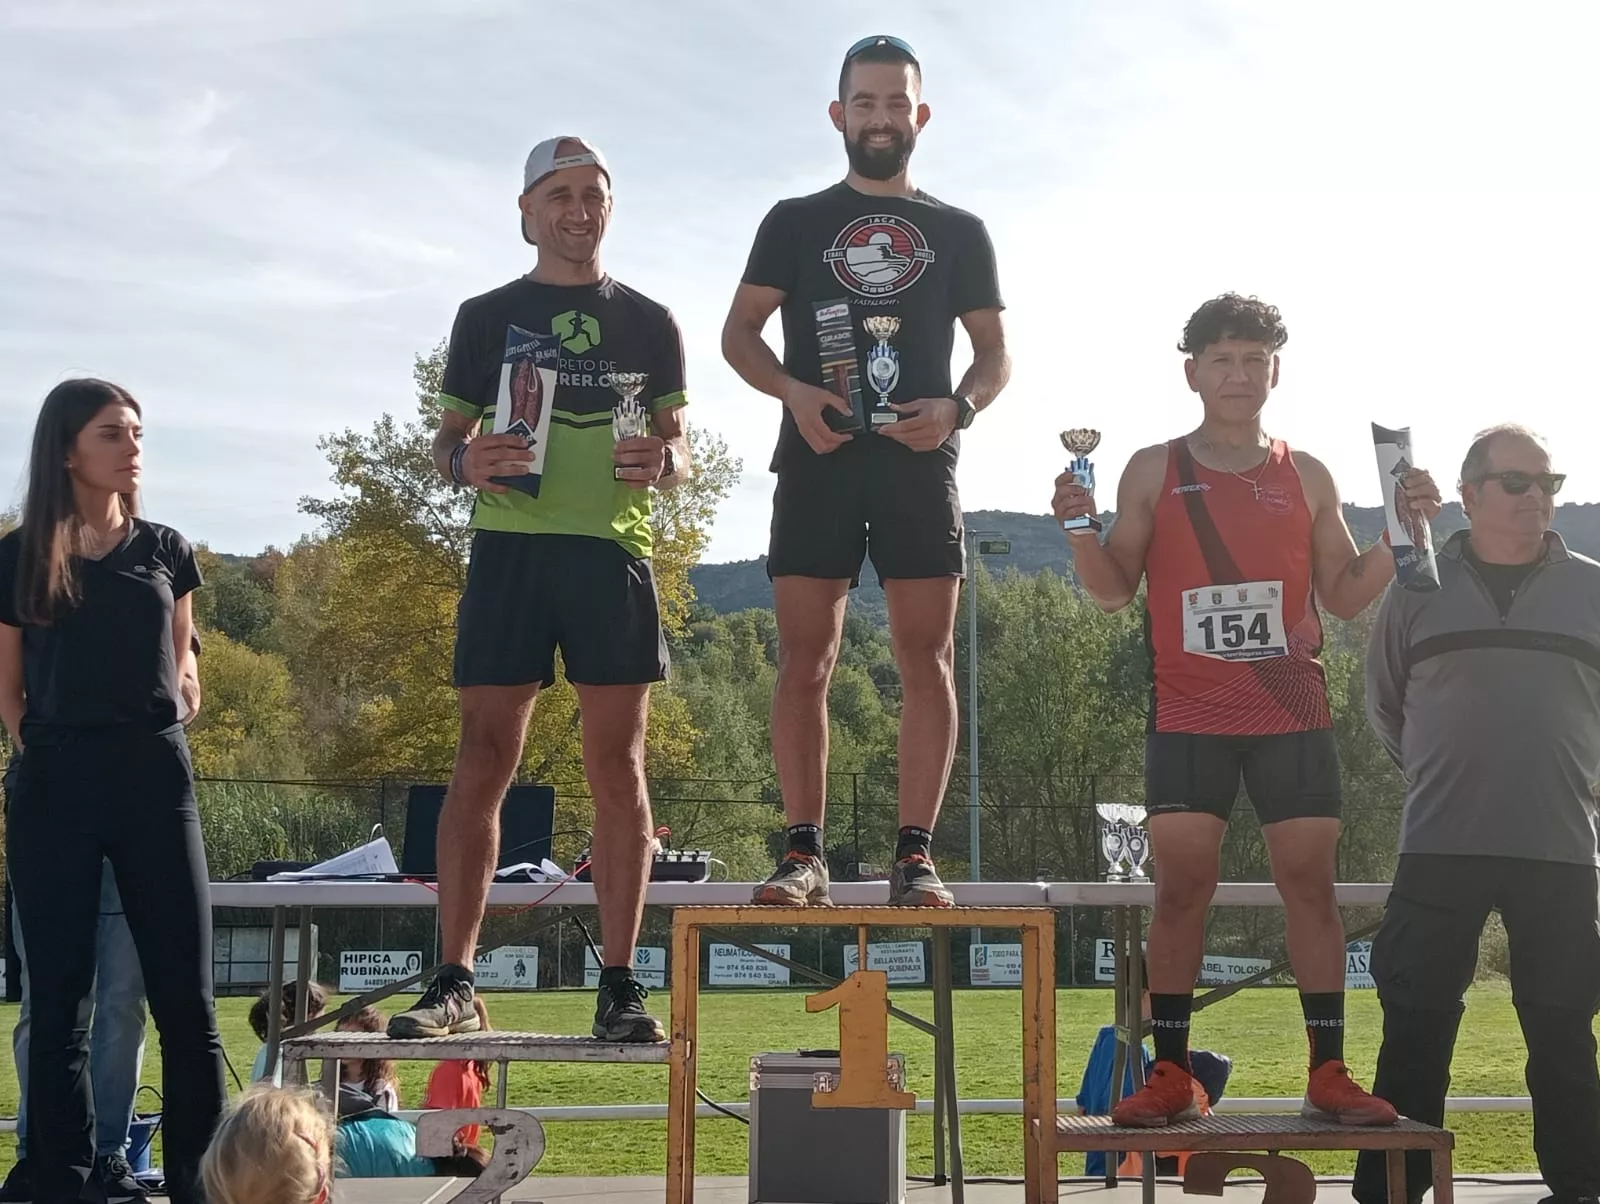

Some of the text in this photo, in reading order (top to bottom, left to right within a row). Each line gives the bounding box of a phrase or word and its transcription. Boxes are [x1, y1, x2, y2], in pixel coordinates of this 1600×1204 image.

[869, 217, 896, 225] JACA
[559, 358, 617, 371] RETO DE
[1198, 612, 1271, 650] 154
[344, 954, 391, 963] HIPICA
[341, 965, 409, 975] RUBIÑANA
